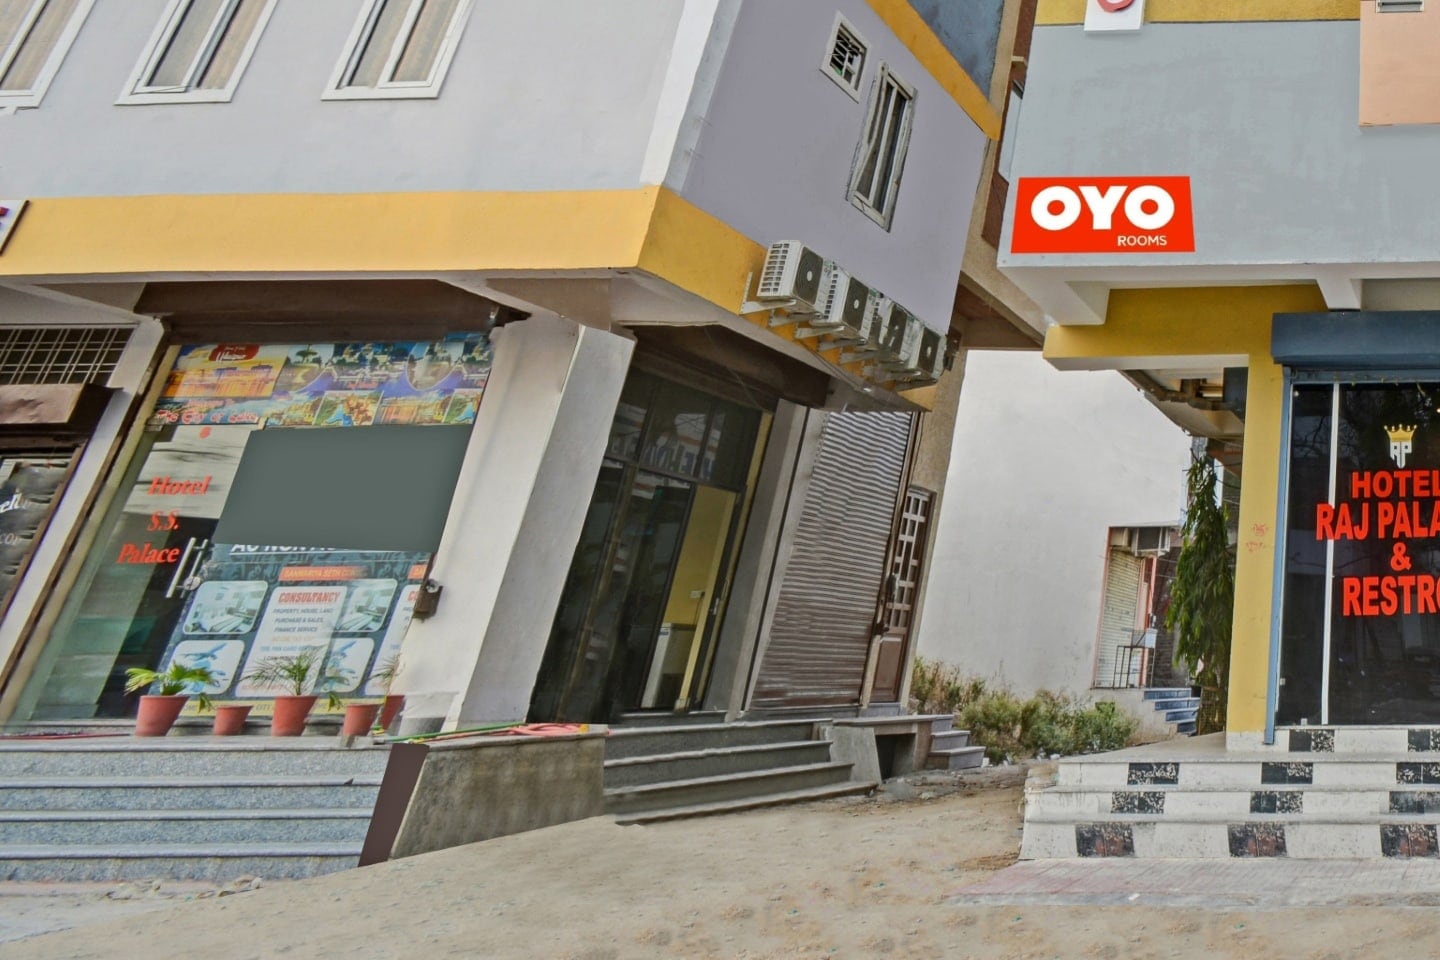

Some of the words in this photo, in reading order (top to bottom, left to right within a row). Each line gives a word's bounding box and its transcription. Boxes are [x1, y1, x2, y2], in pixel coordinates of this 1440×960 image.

[1030, 185, 1175, 231] OYO
[1117, 235, 1168, 247] ROOMS
[147, 474, 213, 496] Hotel
[1316, 502, 1370, 540] RAJ
[116, 543, 180, 564] Palace
[1390, 542, 1412, 571] &
[278, 591, 341, 604] CONSULTANCY
